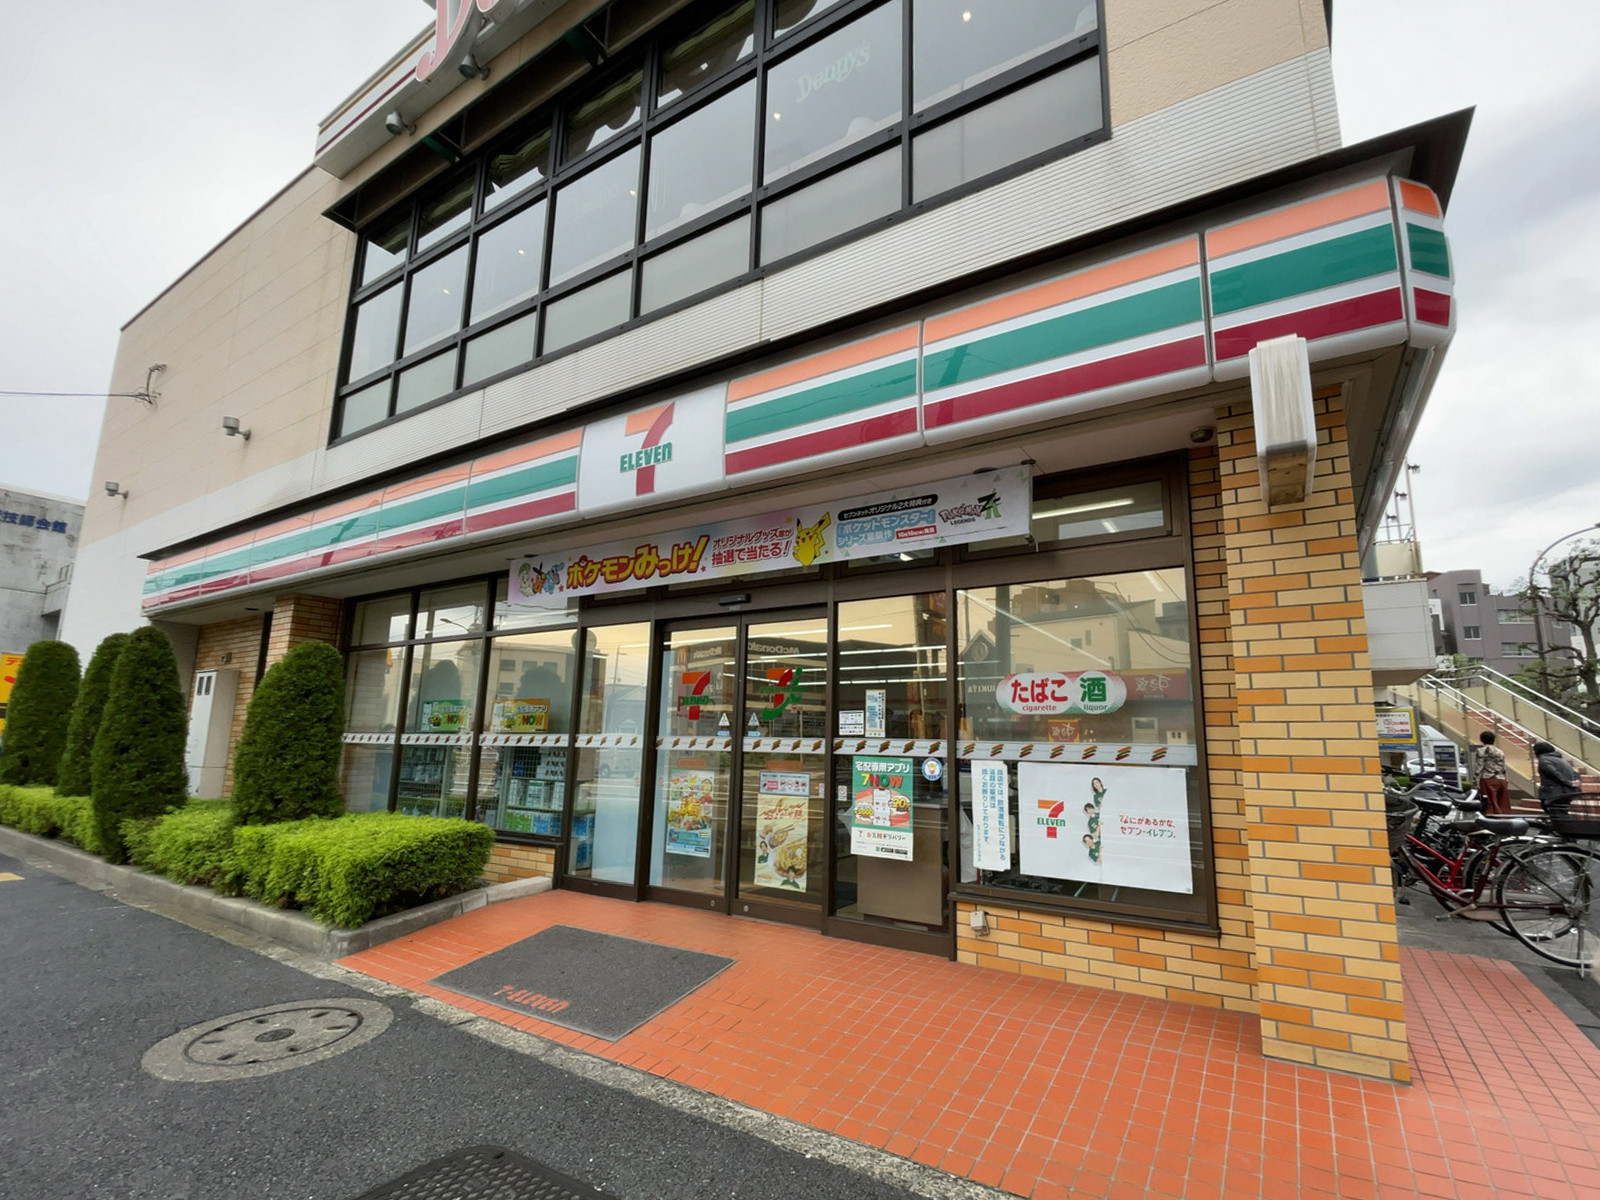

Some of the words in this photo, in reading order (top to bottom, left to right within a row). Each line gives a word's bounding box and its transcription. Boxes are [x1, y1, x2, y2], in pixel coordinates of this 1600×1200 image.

[625, 402, 675, 496] 7
[1010, 677, 1069, 704] たばこ
[1080, 677, 1107, 703] 酒
[1022, 704, 1057, 713] cigarette
[1083, 703, 1108, 713] liquor
[1037, 799, 1065, 839] 7
